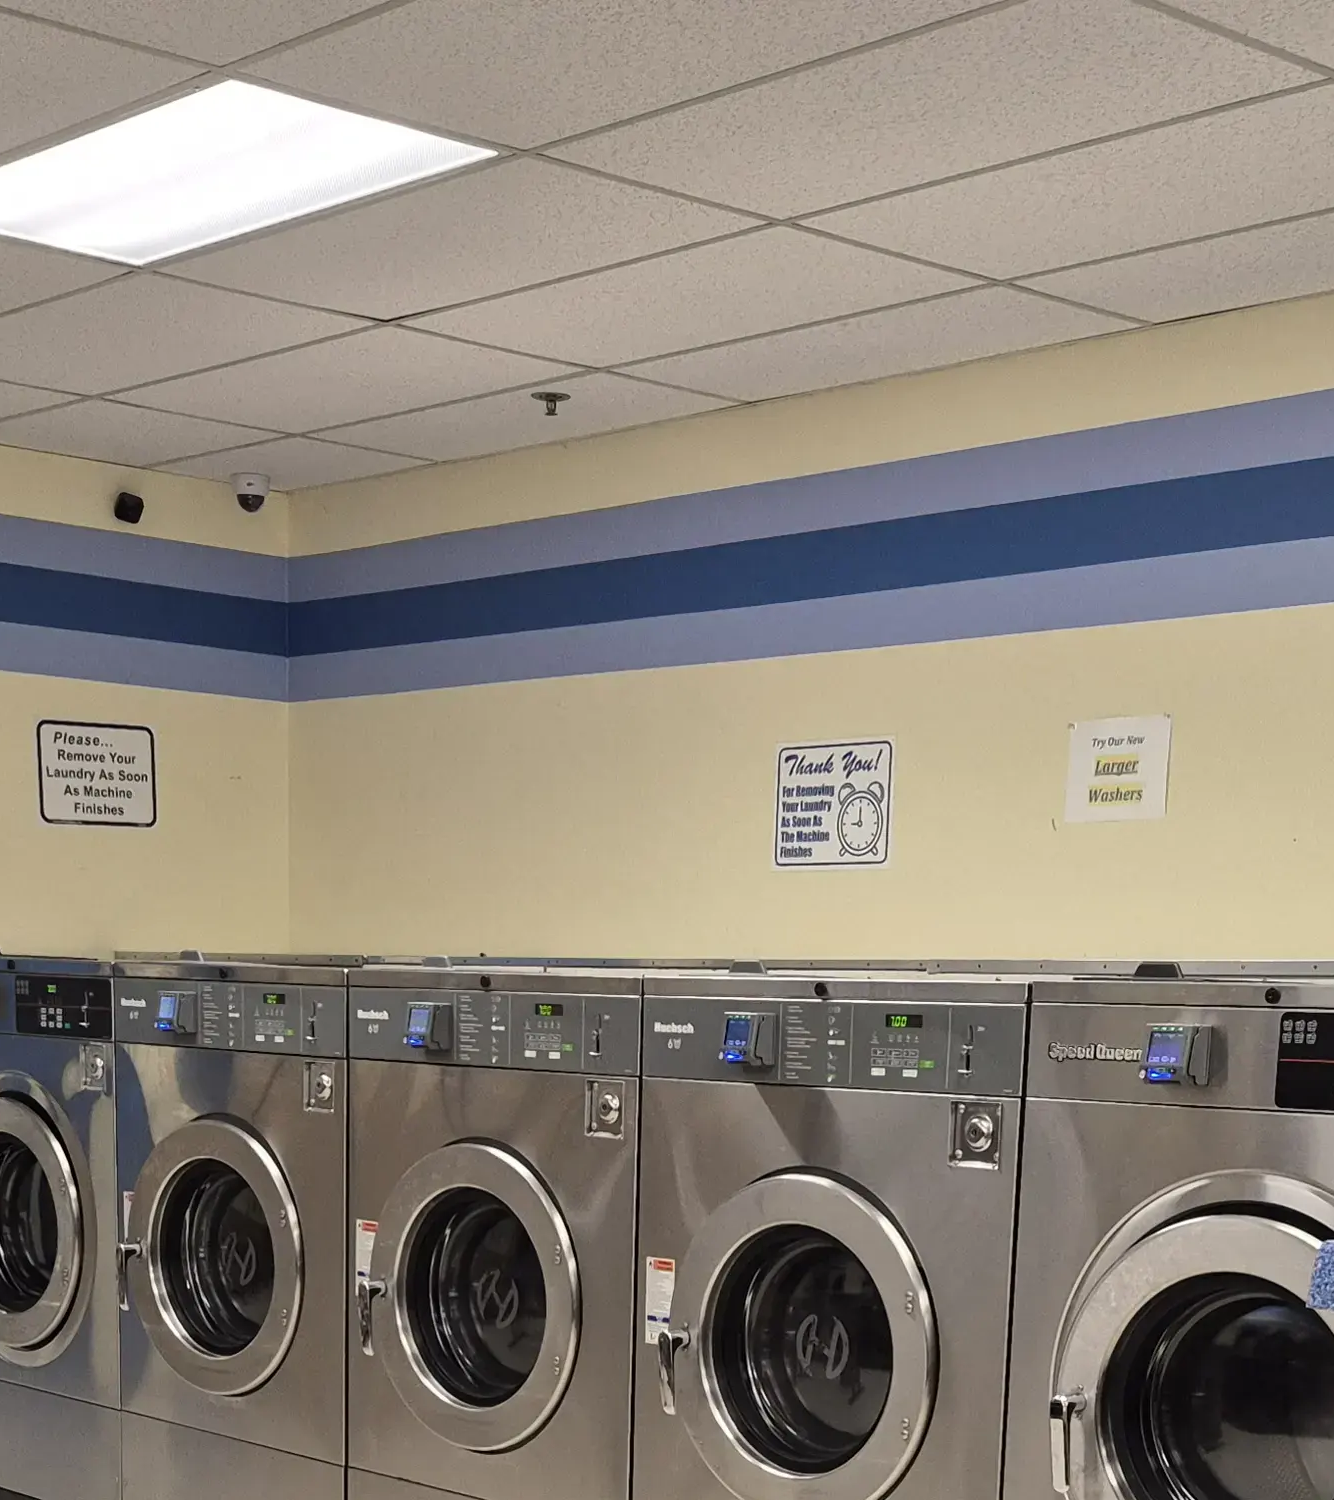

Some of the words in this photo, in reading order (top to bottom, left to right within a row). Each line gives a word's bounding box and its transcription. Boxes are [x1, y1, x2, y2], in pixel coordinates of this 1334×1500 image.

[53, 731, 113, 747] Please...
[1092, 738, 1106, 750] Try
[1107, 737, 1125, 747] Our
[1126, 735, 1145, 745] New
[57, 749, 105, 763] Remove
[109, 752, 136, 764] Your
[784, 753, 834, 776] Thank
[841, 749, 883, 779] You!
[46, 766, 95, 782] Laundry
[99, 769, 114, 781] As
[118, 770, 148, 782] Soon
[1094, 760, 1139, 776] Larger
[64, 785, 80, 796] As
[84, 785, 133, 798] Machine
[782, 786, 795, 798] For
[795, 784, 835, 797] Removing
[1088, 786, 1143, 803] Washers
[74, 802, 125, 816] Finishes
[782, 801, 799, 813] Your
[800, 800, 832, 812] Laundry
[780, 816, 790, 828] As
[792, 816, 811, 827] Soon
[812, 815, 823, 827] As
[780, 831, 795, 843] The
[796, 830, 830, 842] Machine
[779, 847, 812, 858] Finishes
[1048, 1042, 1095, 1063] Speed
[1096, 1043, 1143, 1062] Queen
